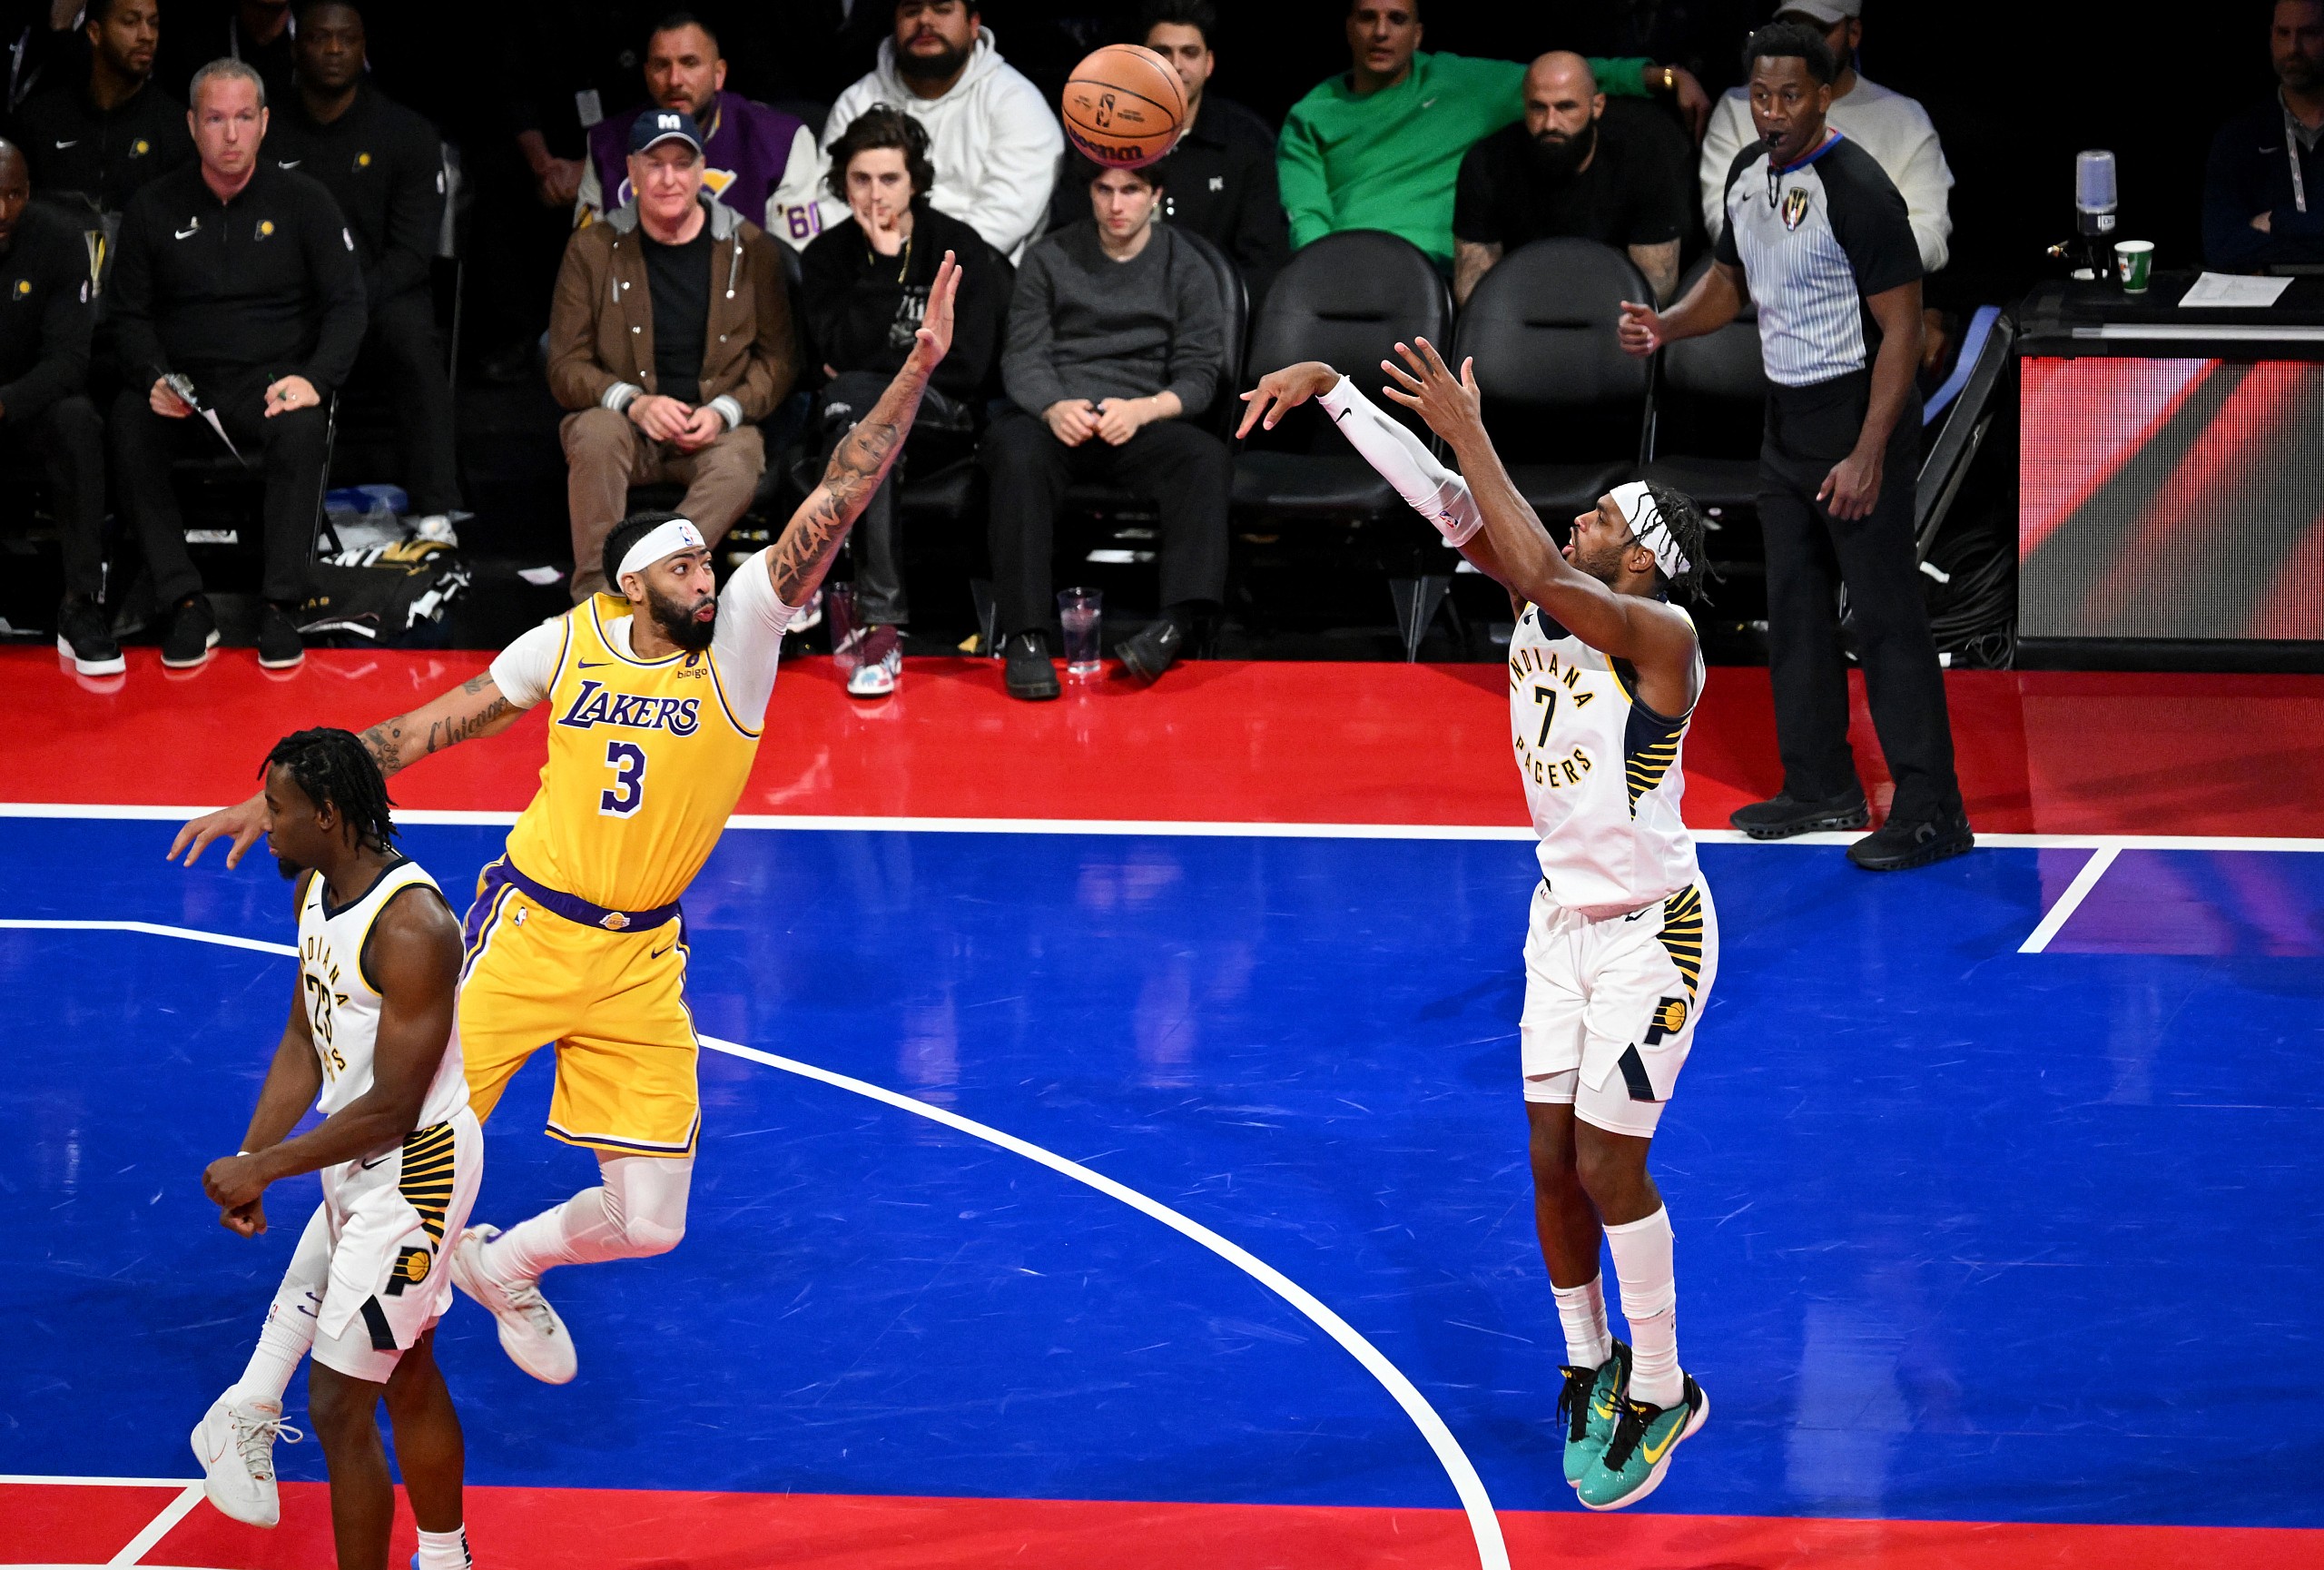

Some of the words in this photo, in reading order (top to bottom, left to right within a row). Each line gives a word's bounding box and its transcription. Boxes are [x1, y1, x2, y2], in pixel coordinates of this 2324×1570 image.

[657, 114, 682, 130] M
[677, 667, 708, 679] bibigo
[1510, 647, 1595, 709] INDIANA
[557, 679, 702, 737] LAKERS
[1534, 684, 1558, 749] 7
[599, 739, 648, 819] 3
[1515, 734, 1592, 789] PACERS
[305, 973, 333, 1046] 23
